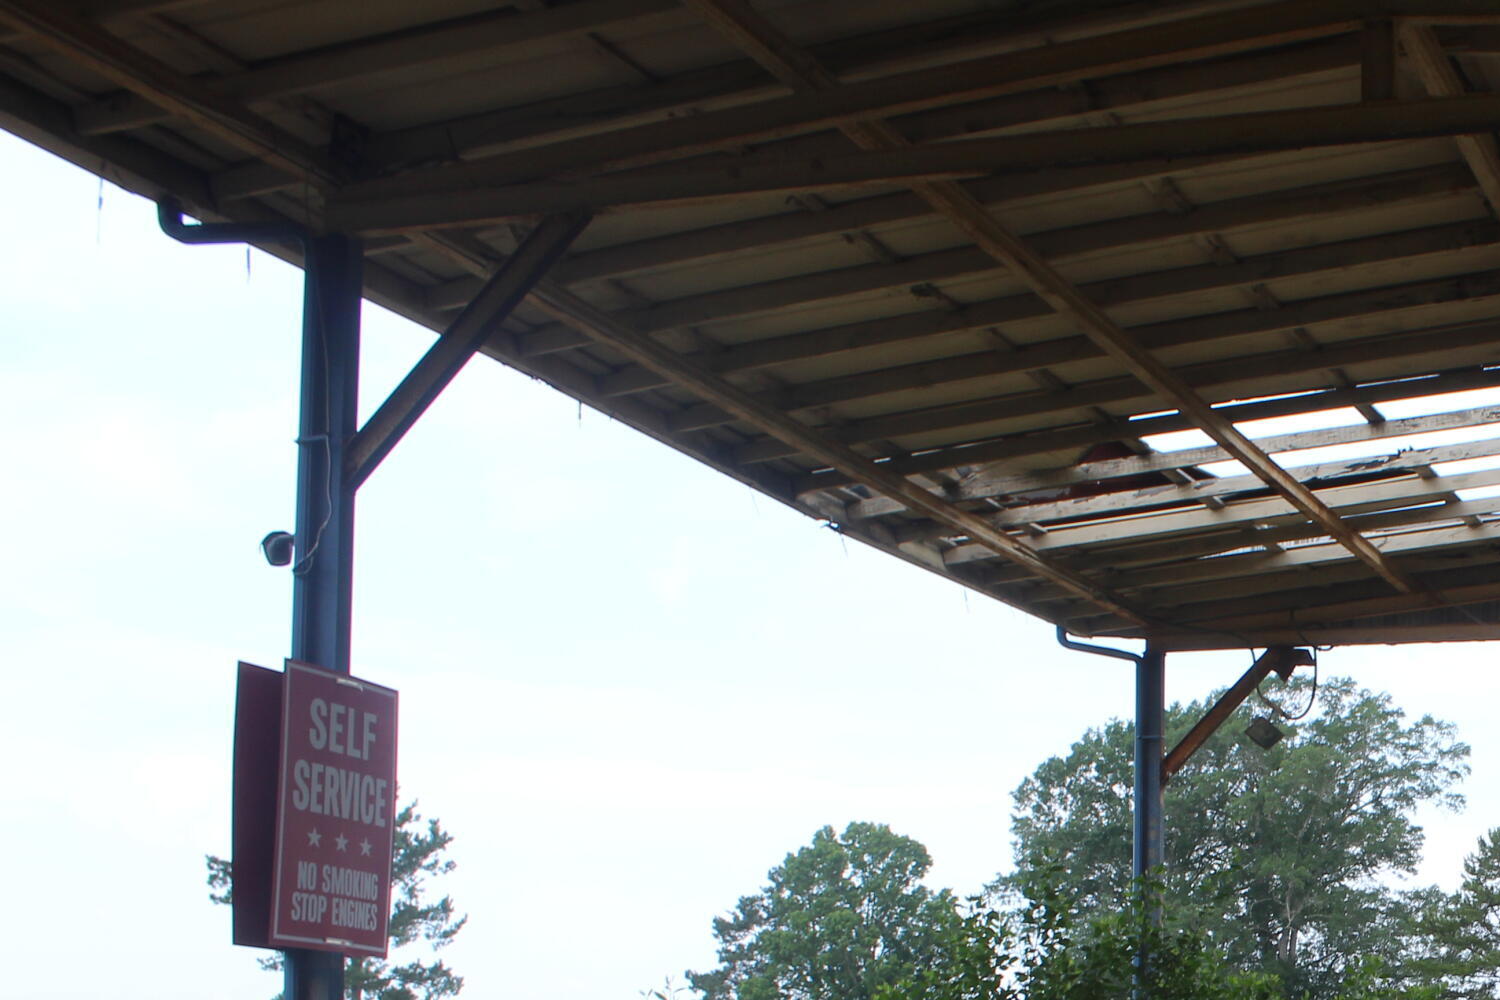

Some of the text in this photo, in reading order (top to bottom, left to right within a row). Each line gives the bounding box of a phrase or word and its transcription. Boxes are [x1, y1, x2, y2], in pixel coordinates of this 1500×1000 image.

[309, 697, 377, 761] SELF
[292, 758, 386, 828] SERVICE
[297, 860, 378, 901] NO SMOKING
[291, 891, 377, 931] STOP ENGINES
